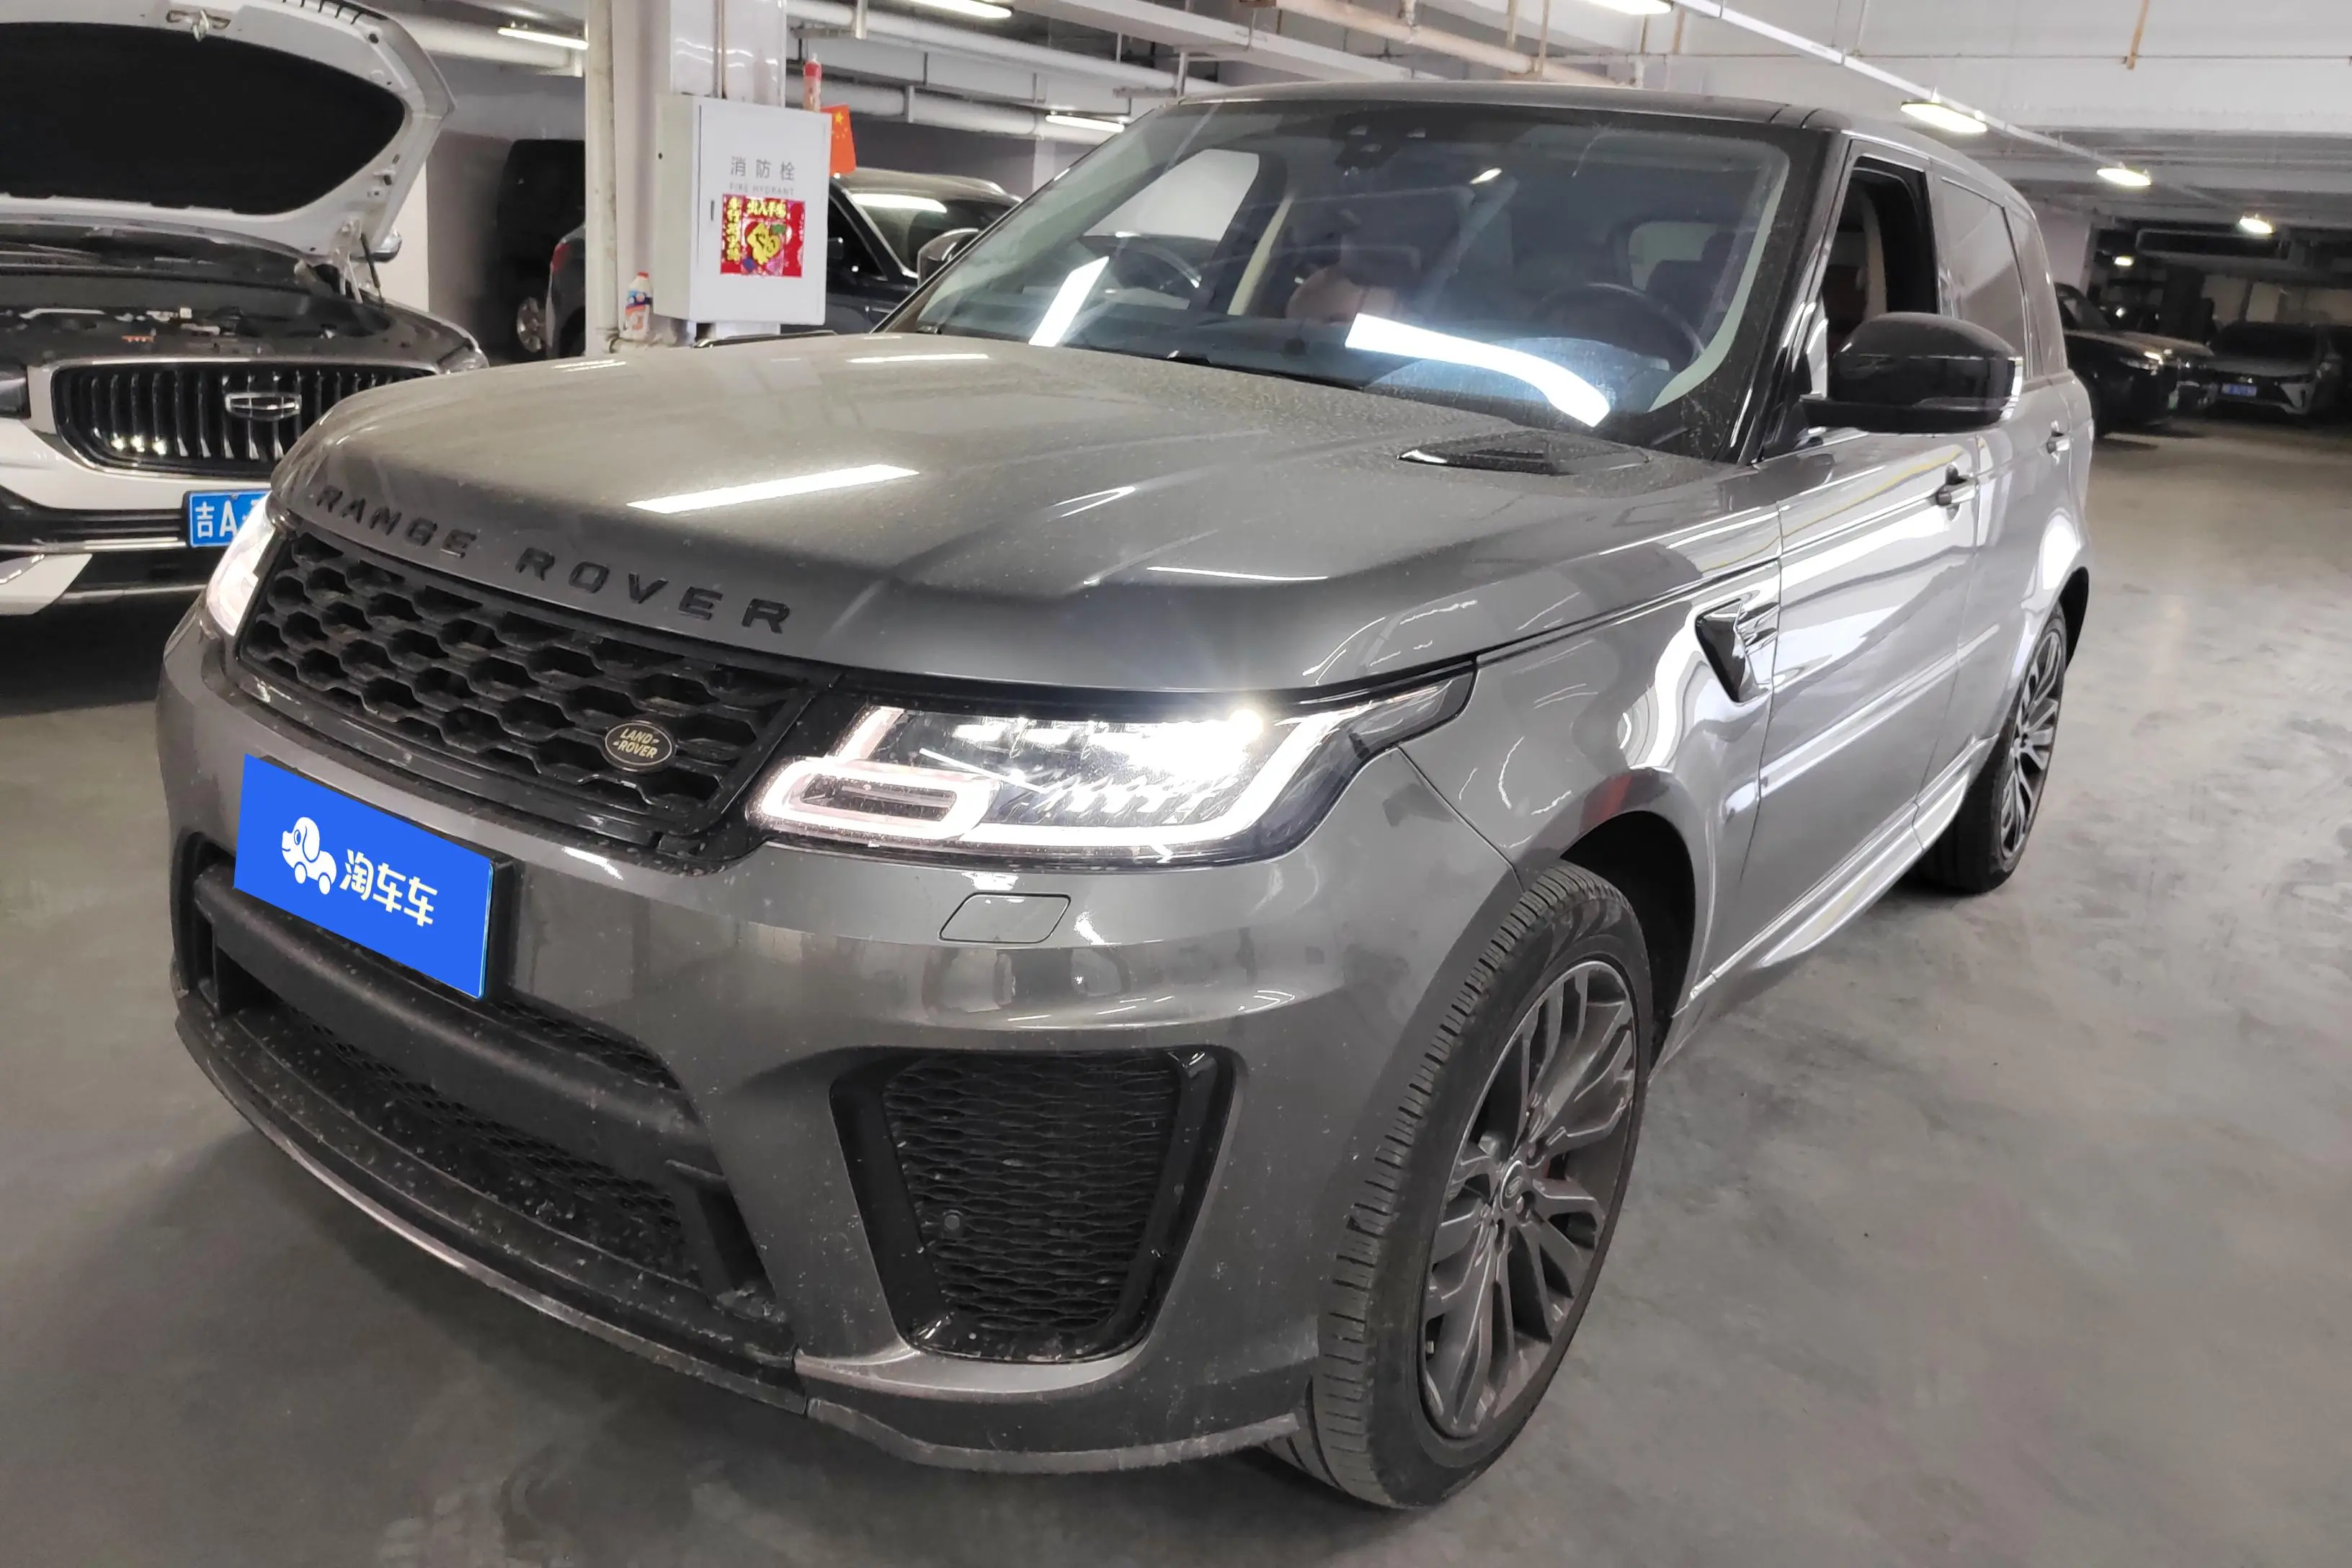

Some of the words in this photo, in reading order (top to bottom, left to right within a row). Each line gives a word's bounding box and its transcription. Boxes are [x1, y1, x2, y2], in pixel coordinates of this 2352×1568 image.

[731, 155, 796, 181] 消防栓
[195, 499, 262, 538] 吉A
[315, 484, 478, 559] RANGE
[515, 547, 790, 634] ROVER
[620, 727, 654, 744] LAND
[617, 739, 659, 759] ROVER
